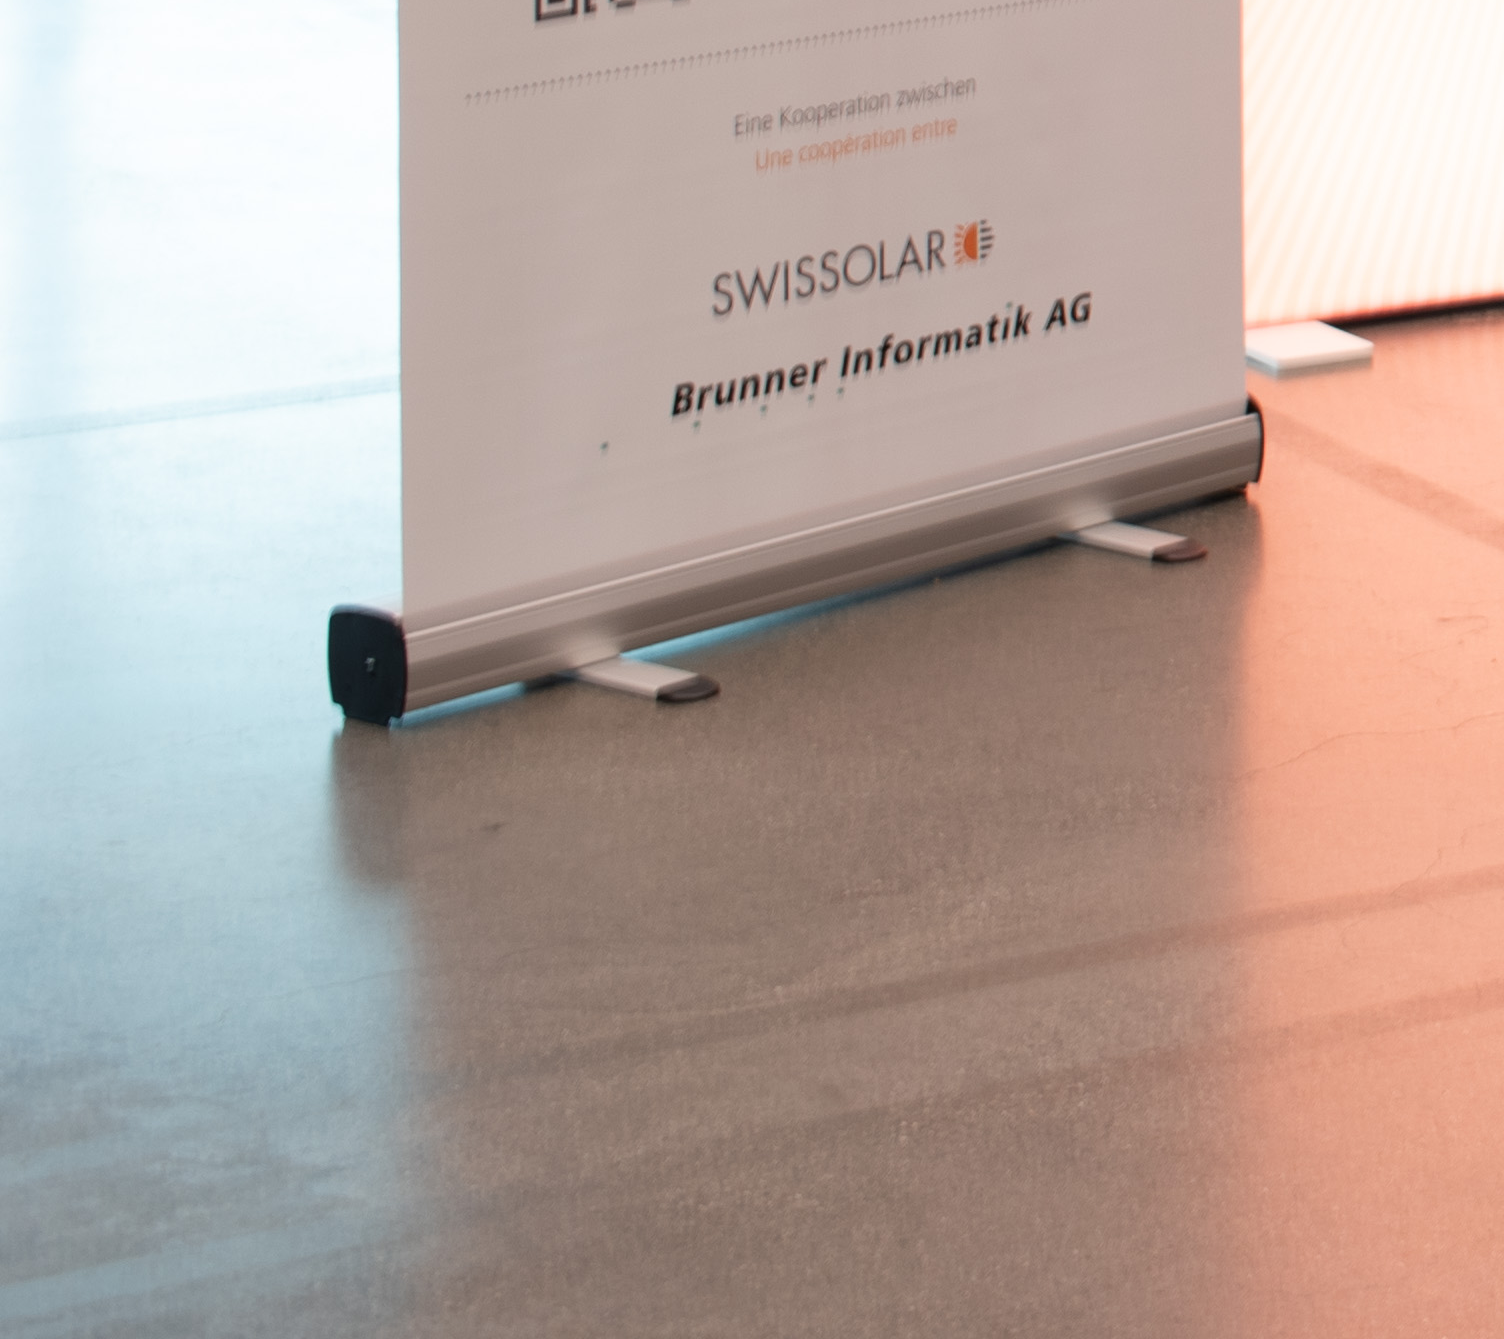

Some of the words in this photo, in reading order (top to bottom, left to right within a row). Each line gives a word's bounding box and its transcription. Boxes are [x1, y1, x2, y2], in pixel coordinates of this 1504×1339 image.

[734, 110, 773, 136] Eine
[780, 91, 891, 130] Kooperation
[896, 75, 976, 107] zwischen
[755, 148, 793, 172] Une
[799, 126, 906, 164] coopération
[912, 116, 958, 141] entre
[711, 229, 947, 316] SWISSOLAR
[671, 355, 828, 417] Brunner
[840, 304, 1032, 379] Informatik
[1044, 291, 1093, 333] AG
